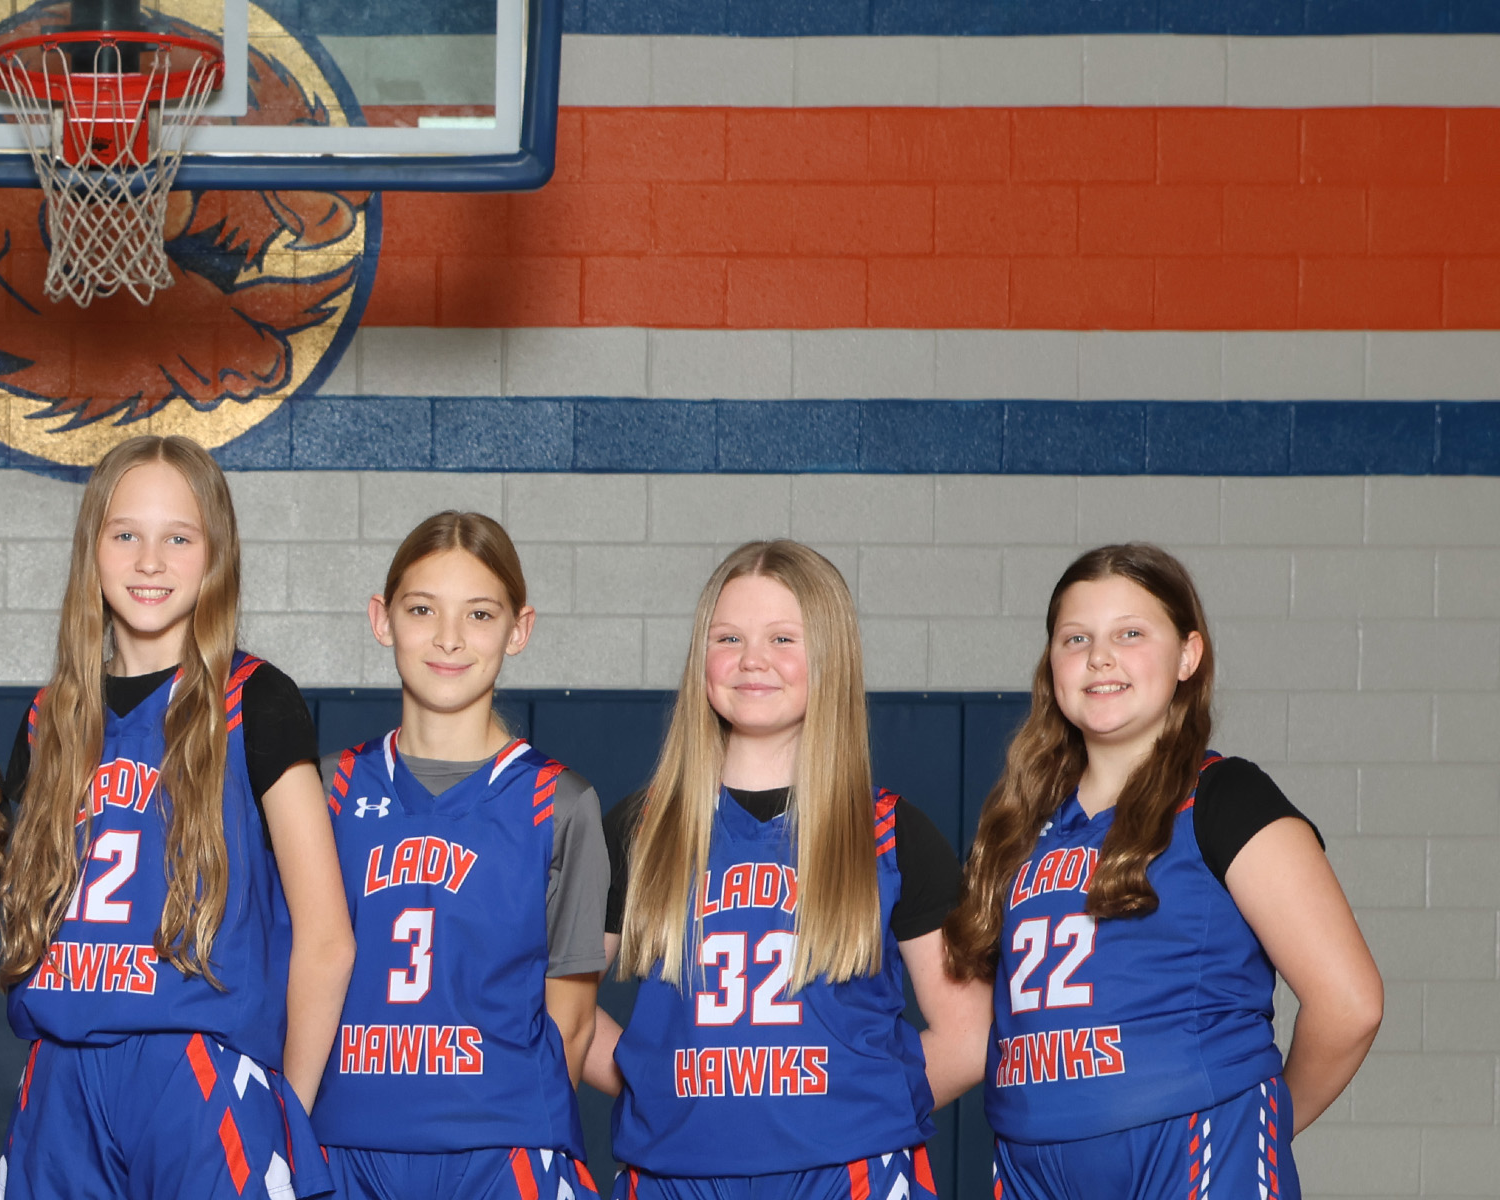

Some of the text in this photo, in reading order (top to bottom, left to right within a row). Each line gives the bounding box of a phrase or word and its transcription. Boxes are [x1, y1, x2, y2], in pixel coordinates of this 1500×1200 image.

[364, 836, 478, 897] LADY
[27, 941, 159, 995] AWKS
[386, 907, 435, 1004] 3
[695, 930, 803, 1026] 32
[1010, 912, 1099, 1016] 22
[339, 1025, 484, 1075] HAWKS
[674, 1046, 828, 1098] HAWKS
[996, 1025, 1126, 1088] HAWKS
